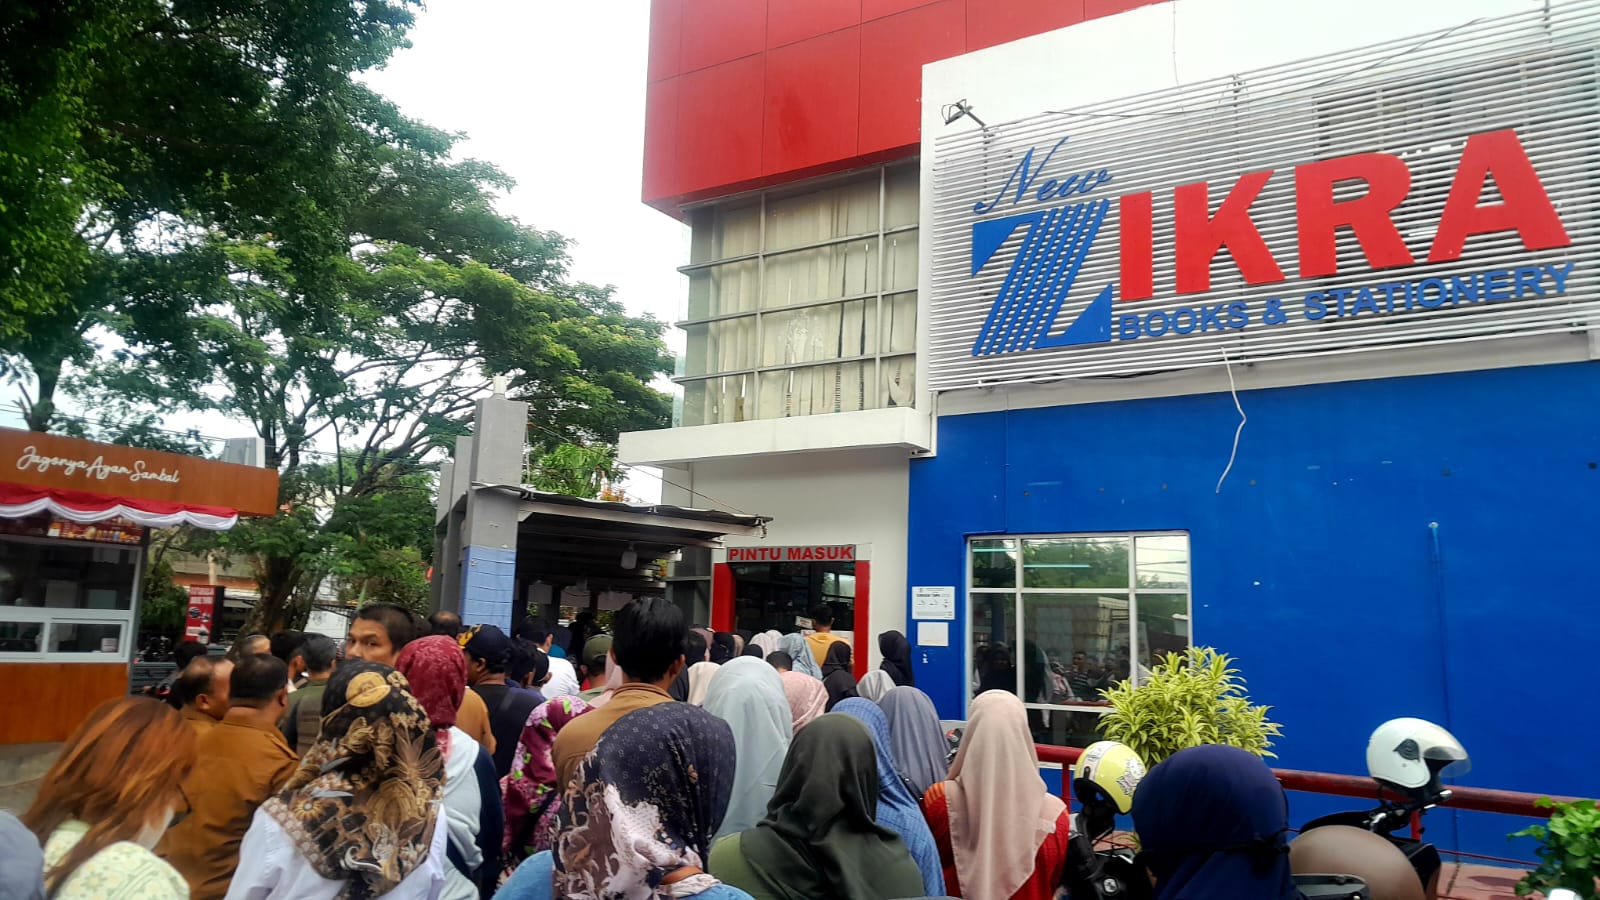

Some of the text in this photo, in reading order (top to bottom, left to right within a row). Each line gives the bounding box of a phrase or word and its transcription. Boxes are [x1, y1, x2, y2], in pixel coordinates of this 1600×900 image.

[973, 136, 1112, 214] New
[971, 128, 1571, 357] ZIKRA
[1118, 262, 1574, 341] BOOKS & STATIONERY
[17, 446, 180, 482] Jagonya Ayam Sambal
[729, 546, 853, 561] PINTU MASUK
